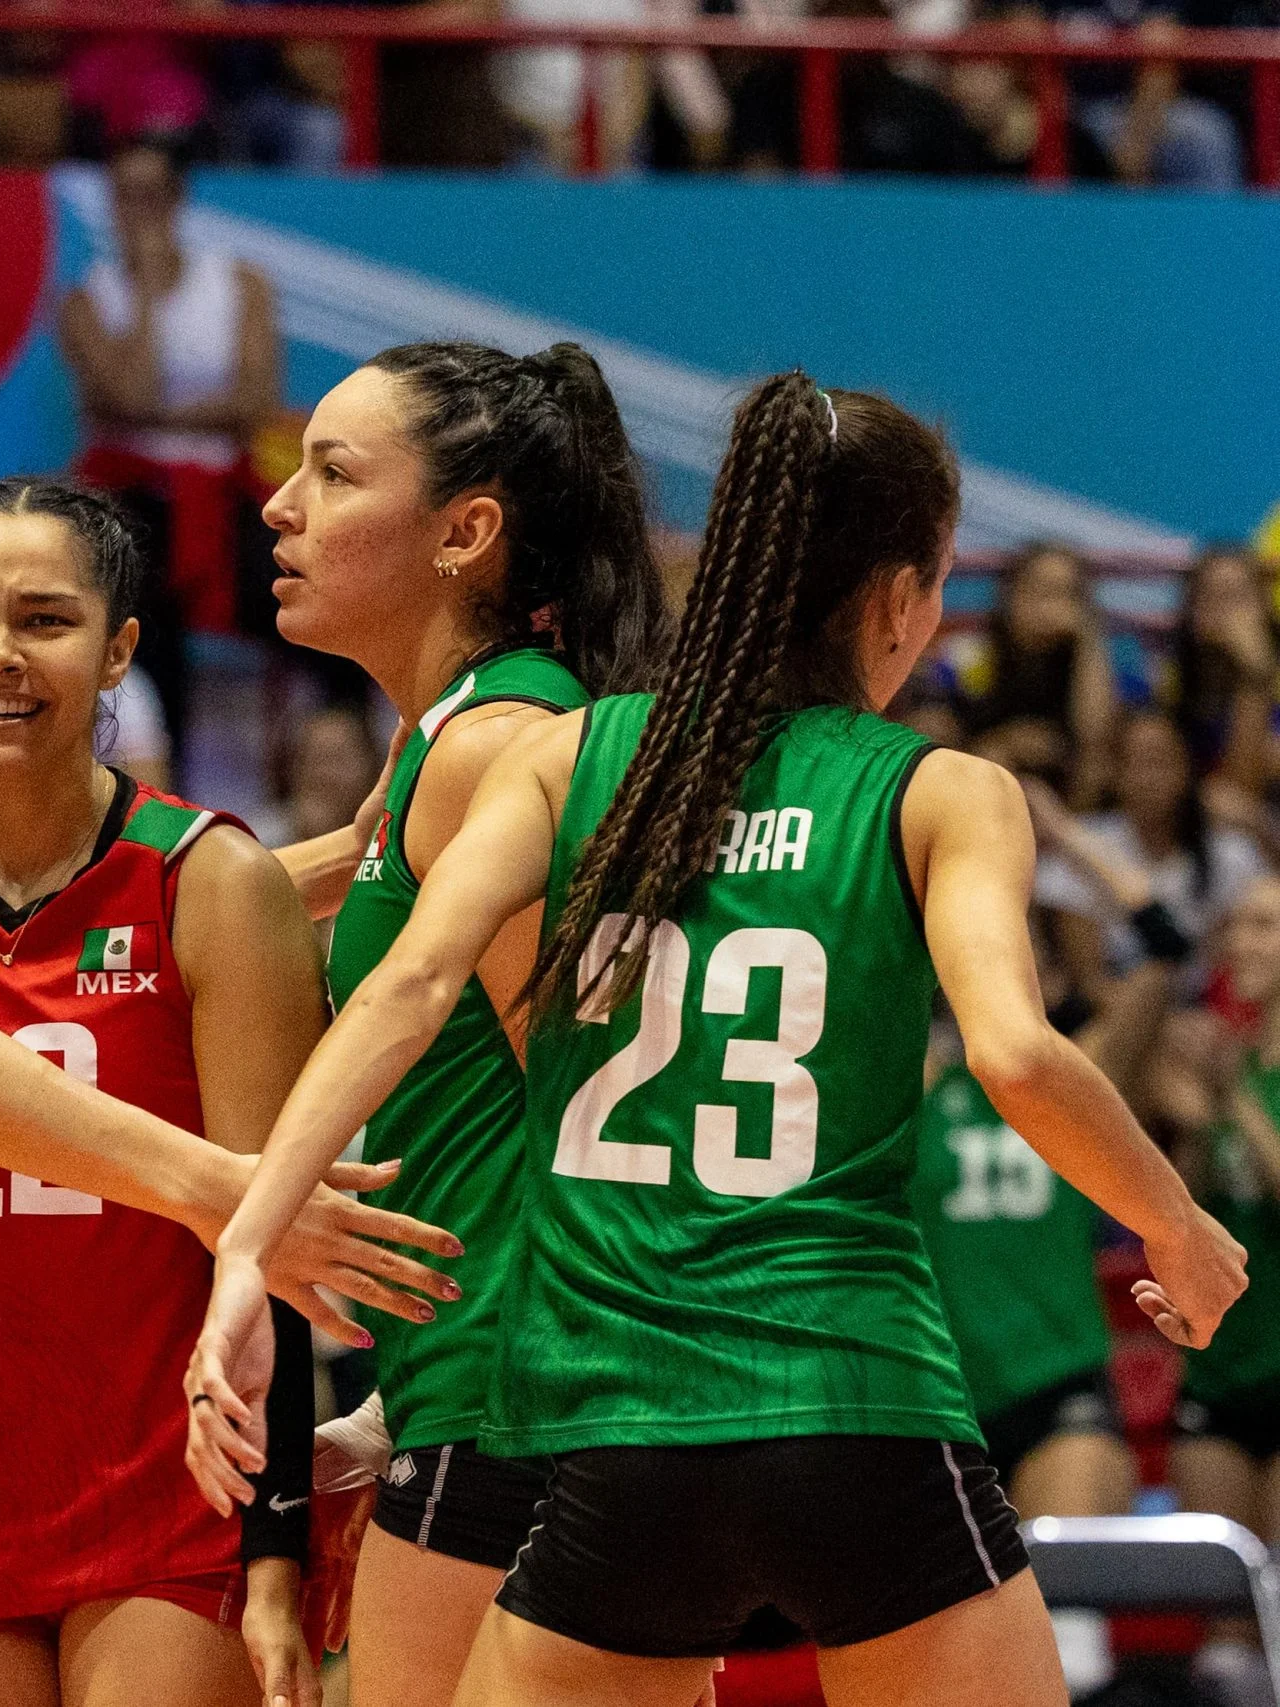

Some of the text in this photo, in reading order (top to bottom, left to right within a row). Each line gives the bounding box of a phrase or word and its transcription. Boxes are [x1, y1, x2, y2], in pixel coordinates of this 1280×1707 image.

[702, 807, 813, 874] RRA
[76, 972, 159, 996] MEX
[551, 913, 828, 1198] 23
